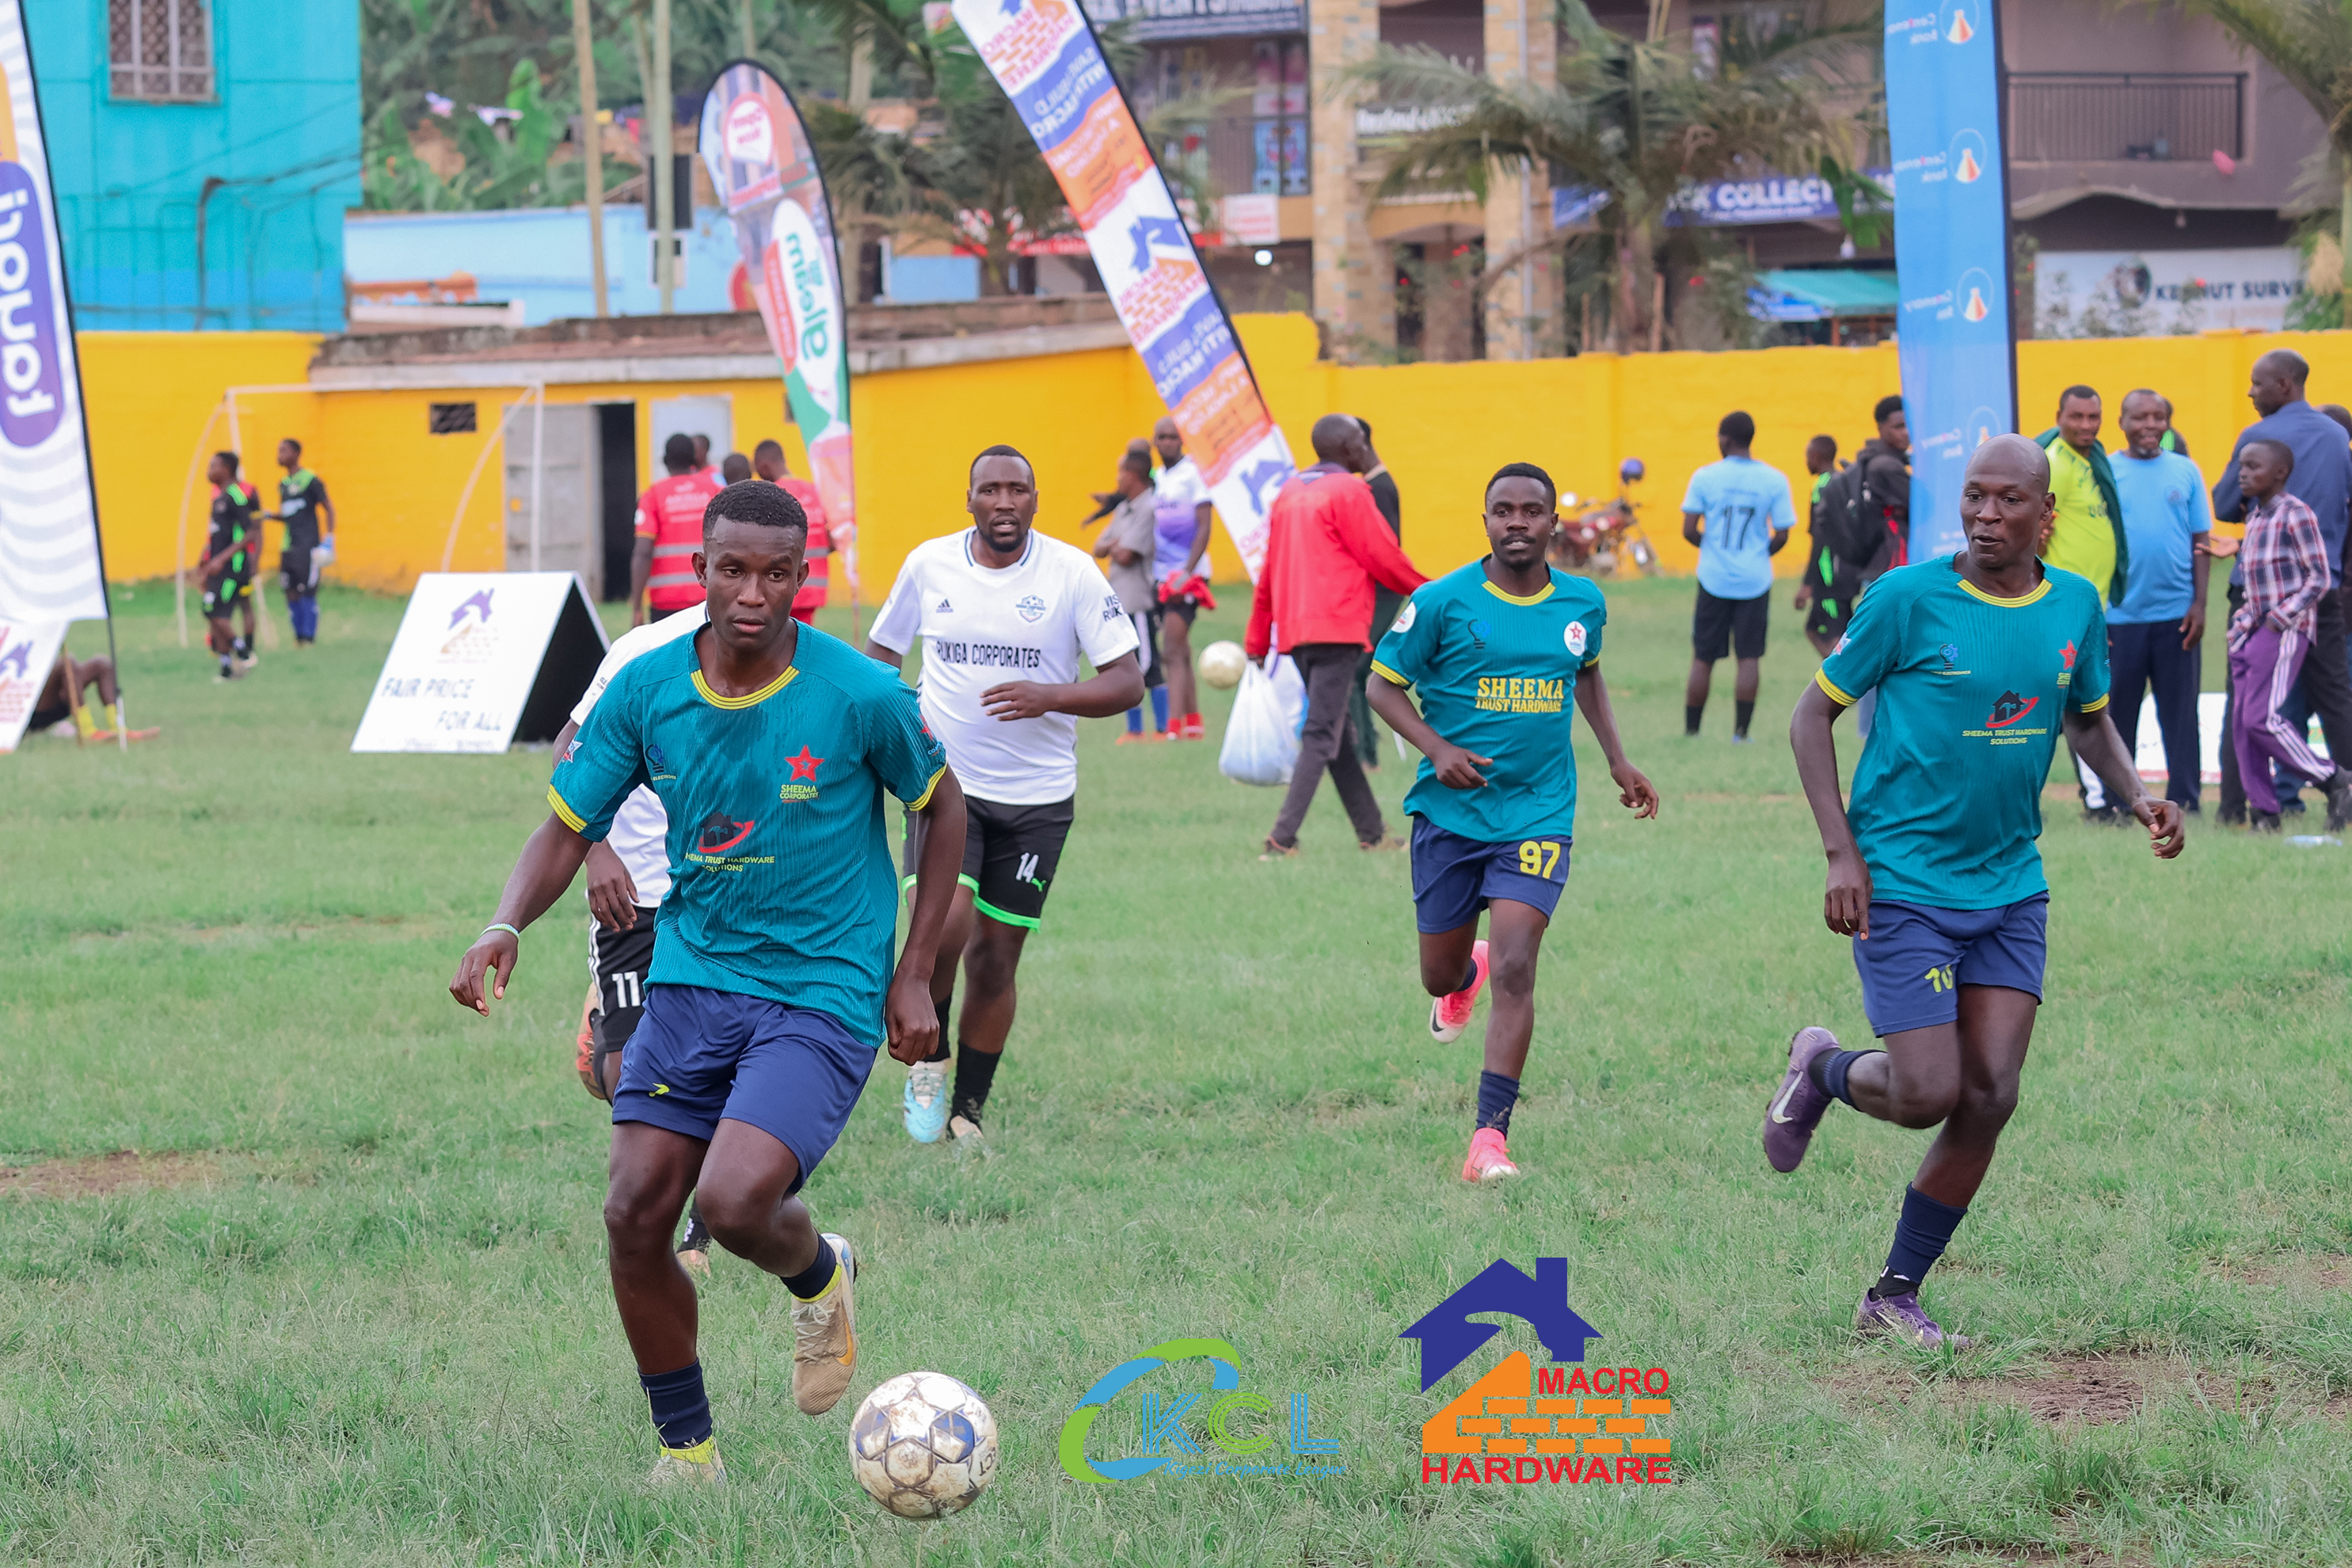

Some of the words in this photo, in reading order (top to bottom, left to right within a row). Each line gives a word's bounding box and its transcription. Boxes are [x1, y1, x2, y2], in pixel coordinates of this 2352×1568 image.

[1721, 504, 1756, 550] 17
[972, 644, 1041, 668] CORPORATES
[1477, 677, 1564, 698] SHEEMA
[1475, 697, 1510, 712] TRUST
[1511, 699, 1562, 714] HARDWARE
[779, 791, 819, 800] CORPORATES
[781, 784, 816, 793] SHEEMA
[705, 855, 725, 864] TRUST
[727, 855, 775, 864] HARDWARE
[1015, 852, 1039, 884] 14
[1519, 840, 1561, 879] 97
[612, 971, 641, 1008] 11
